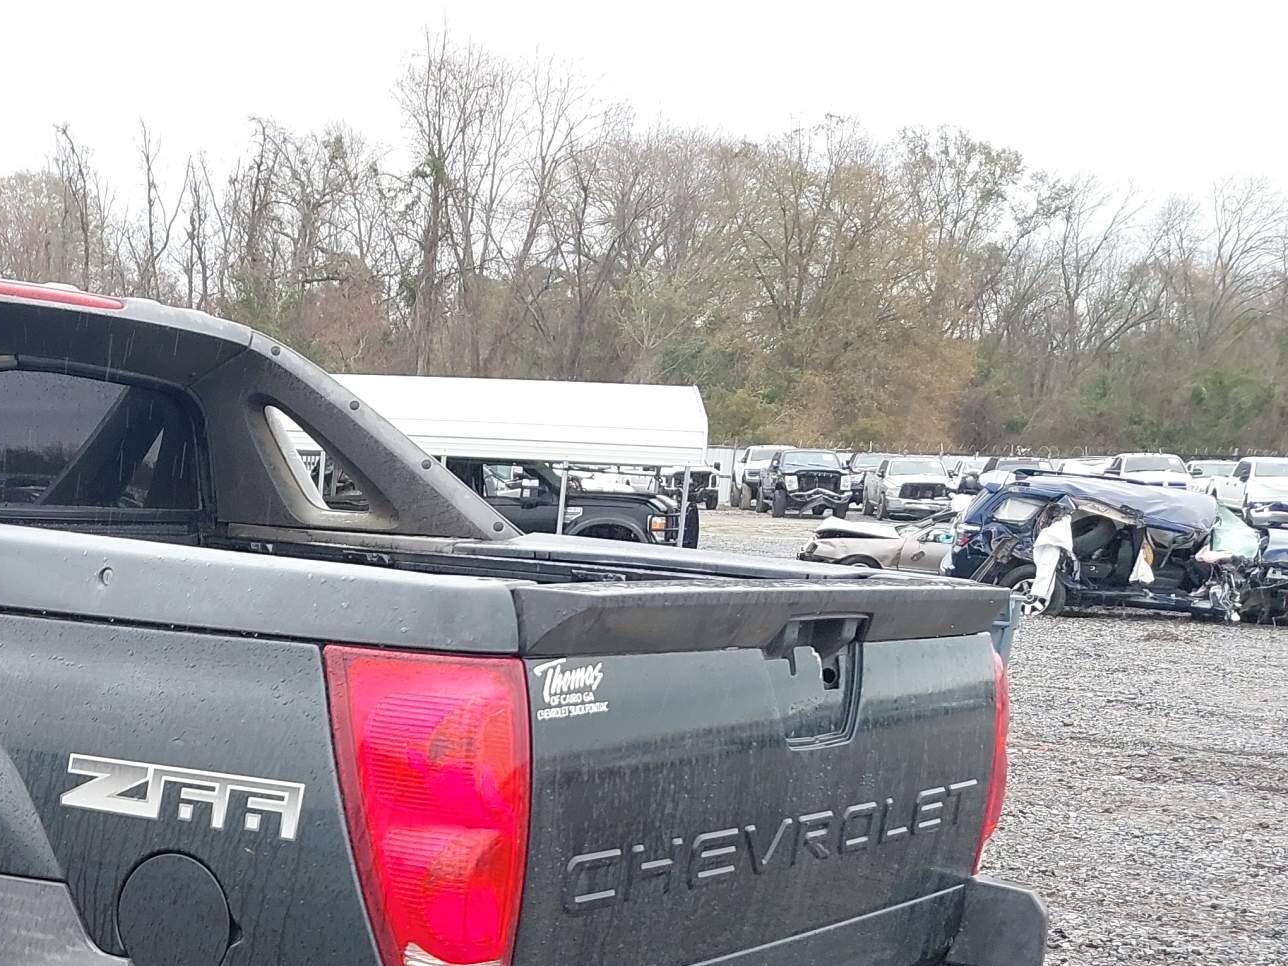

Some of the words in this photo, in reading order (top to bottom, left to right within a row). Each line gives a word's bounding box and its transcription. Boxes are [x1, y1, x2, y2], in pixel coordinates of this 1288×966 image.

[533, 658, 603, 703] Thomas
[550, 694, 561, 706] OF
[562, 779, 978, 914] CHEVROLET
